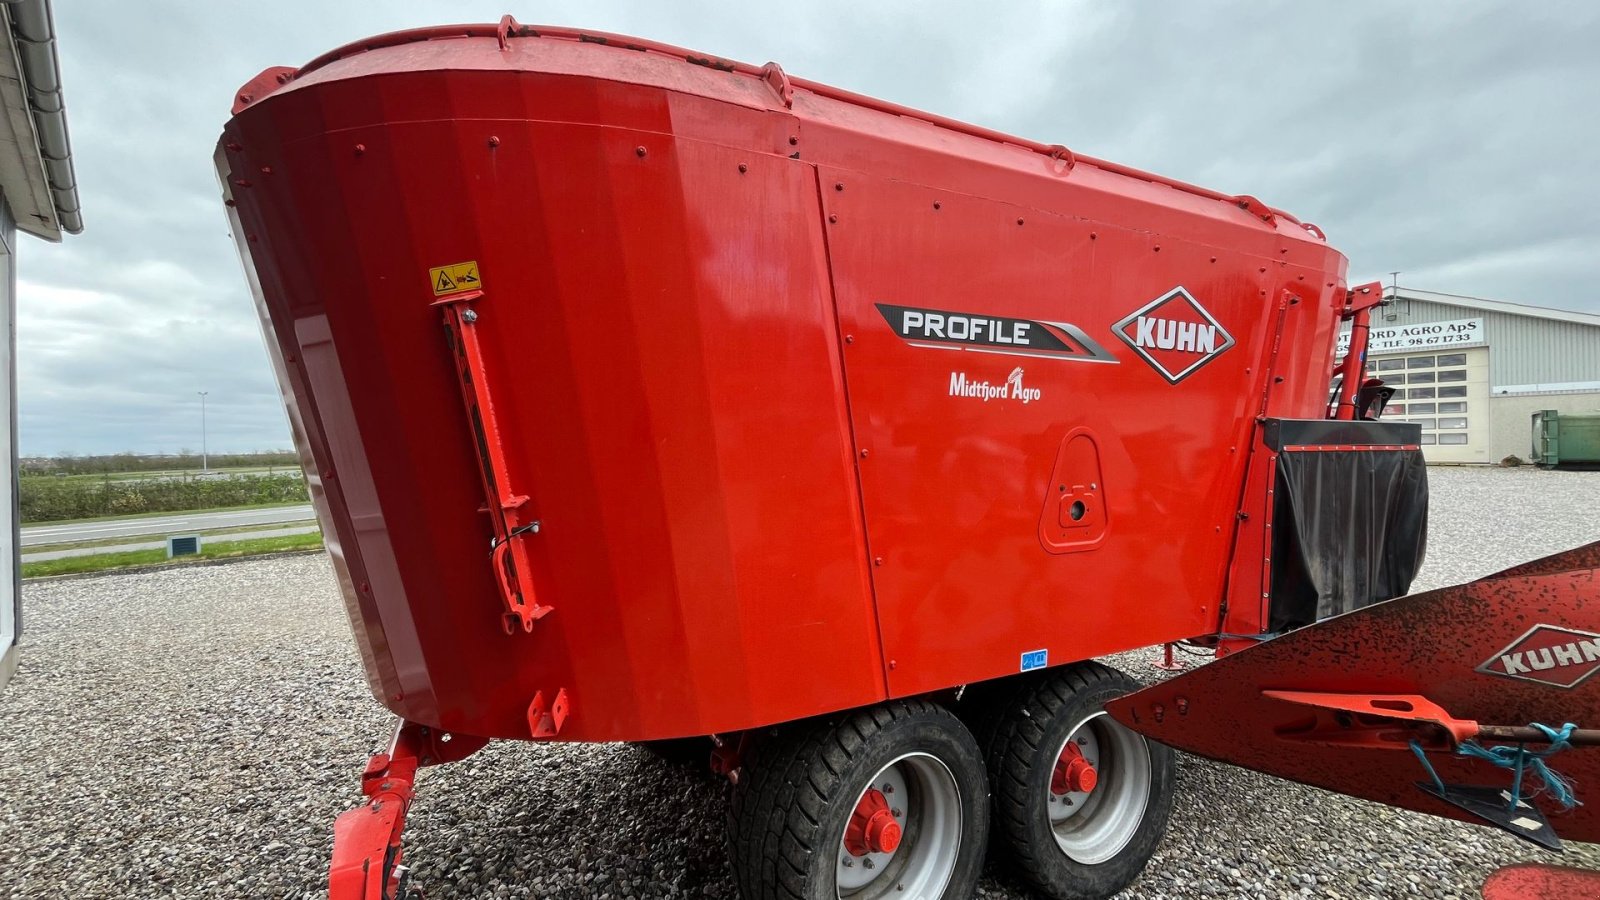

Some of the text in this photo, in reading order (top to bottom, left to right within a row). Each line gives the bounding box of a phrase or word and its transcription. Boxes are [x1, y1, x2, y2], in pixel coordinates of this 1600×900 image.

[902, 310, 1031, 345] PROFILE
[1136, 315, 1216, 354] KUHN
[1401, 325, 1442, 337] AGRO
[1447, 321, 1477, 333] ApS
[1409, 338, 1423, 346] 98
[1427, 336, 1440, 344] 67
[1443, 335, 1454, 343] 17
[1456, 333, 1470, 342] 33
[949, 372, 1041, 404] Midtfjord Agro
[1501, 637, 1600, 675] KUHN
